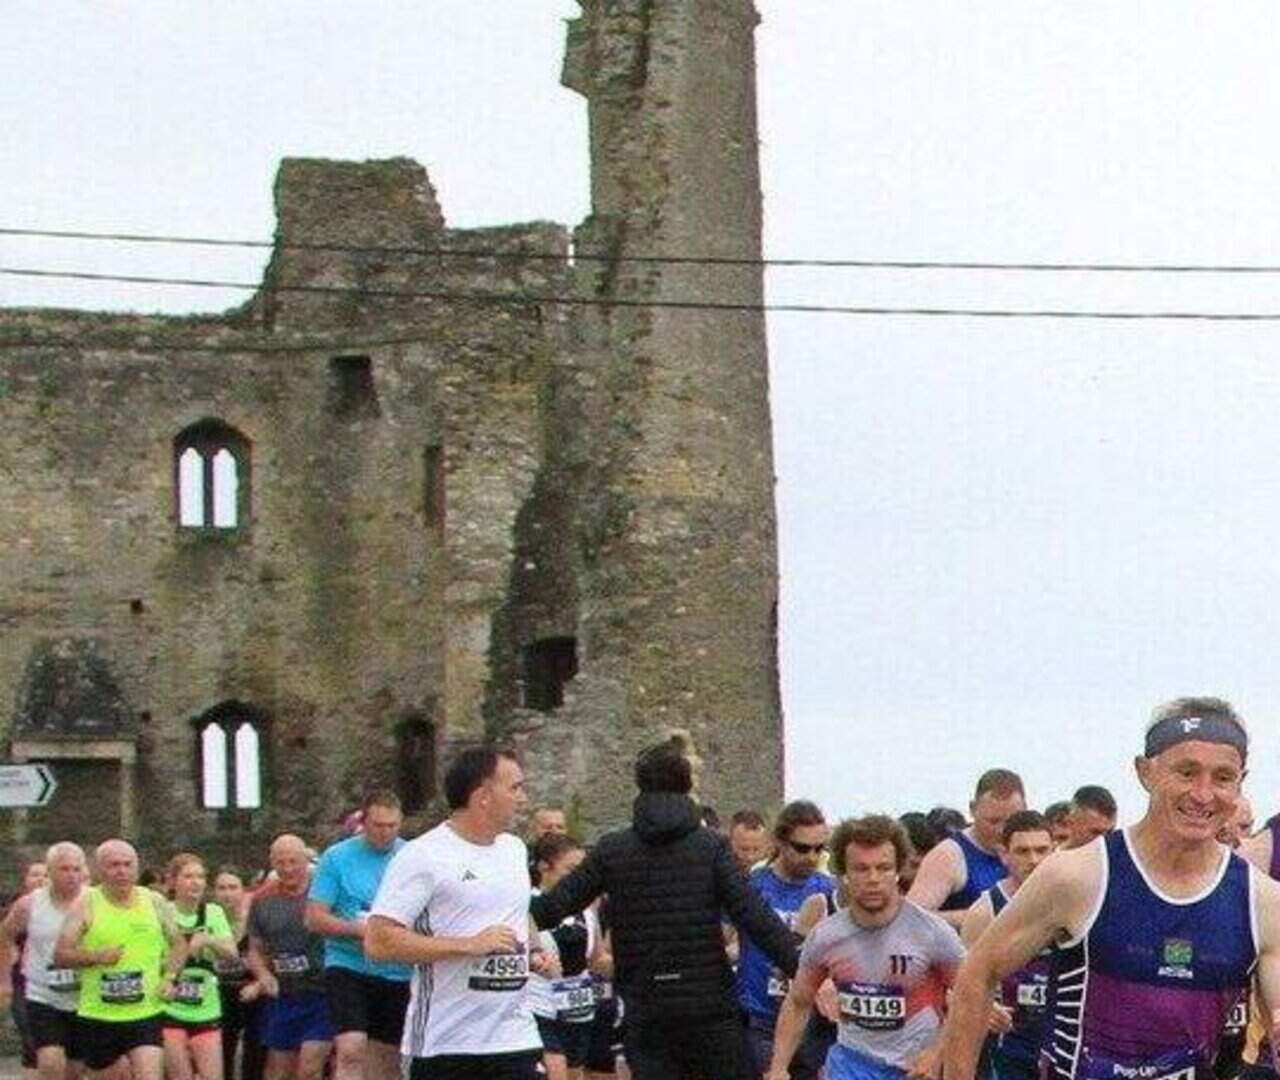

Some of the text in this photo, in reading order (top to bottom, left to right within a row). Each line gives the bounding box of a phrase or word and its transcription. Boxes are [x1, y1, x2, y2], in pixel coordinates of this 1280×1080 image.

[850, 997, 901, 1016] 4149
[1113, 1063, 1158, 1080] Pop Up
